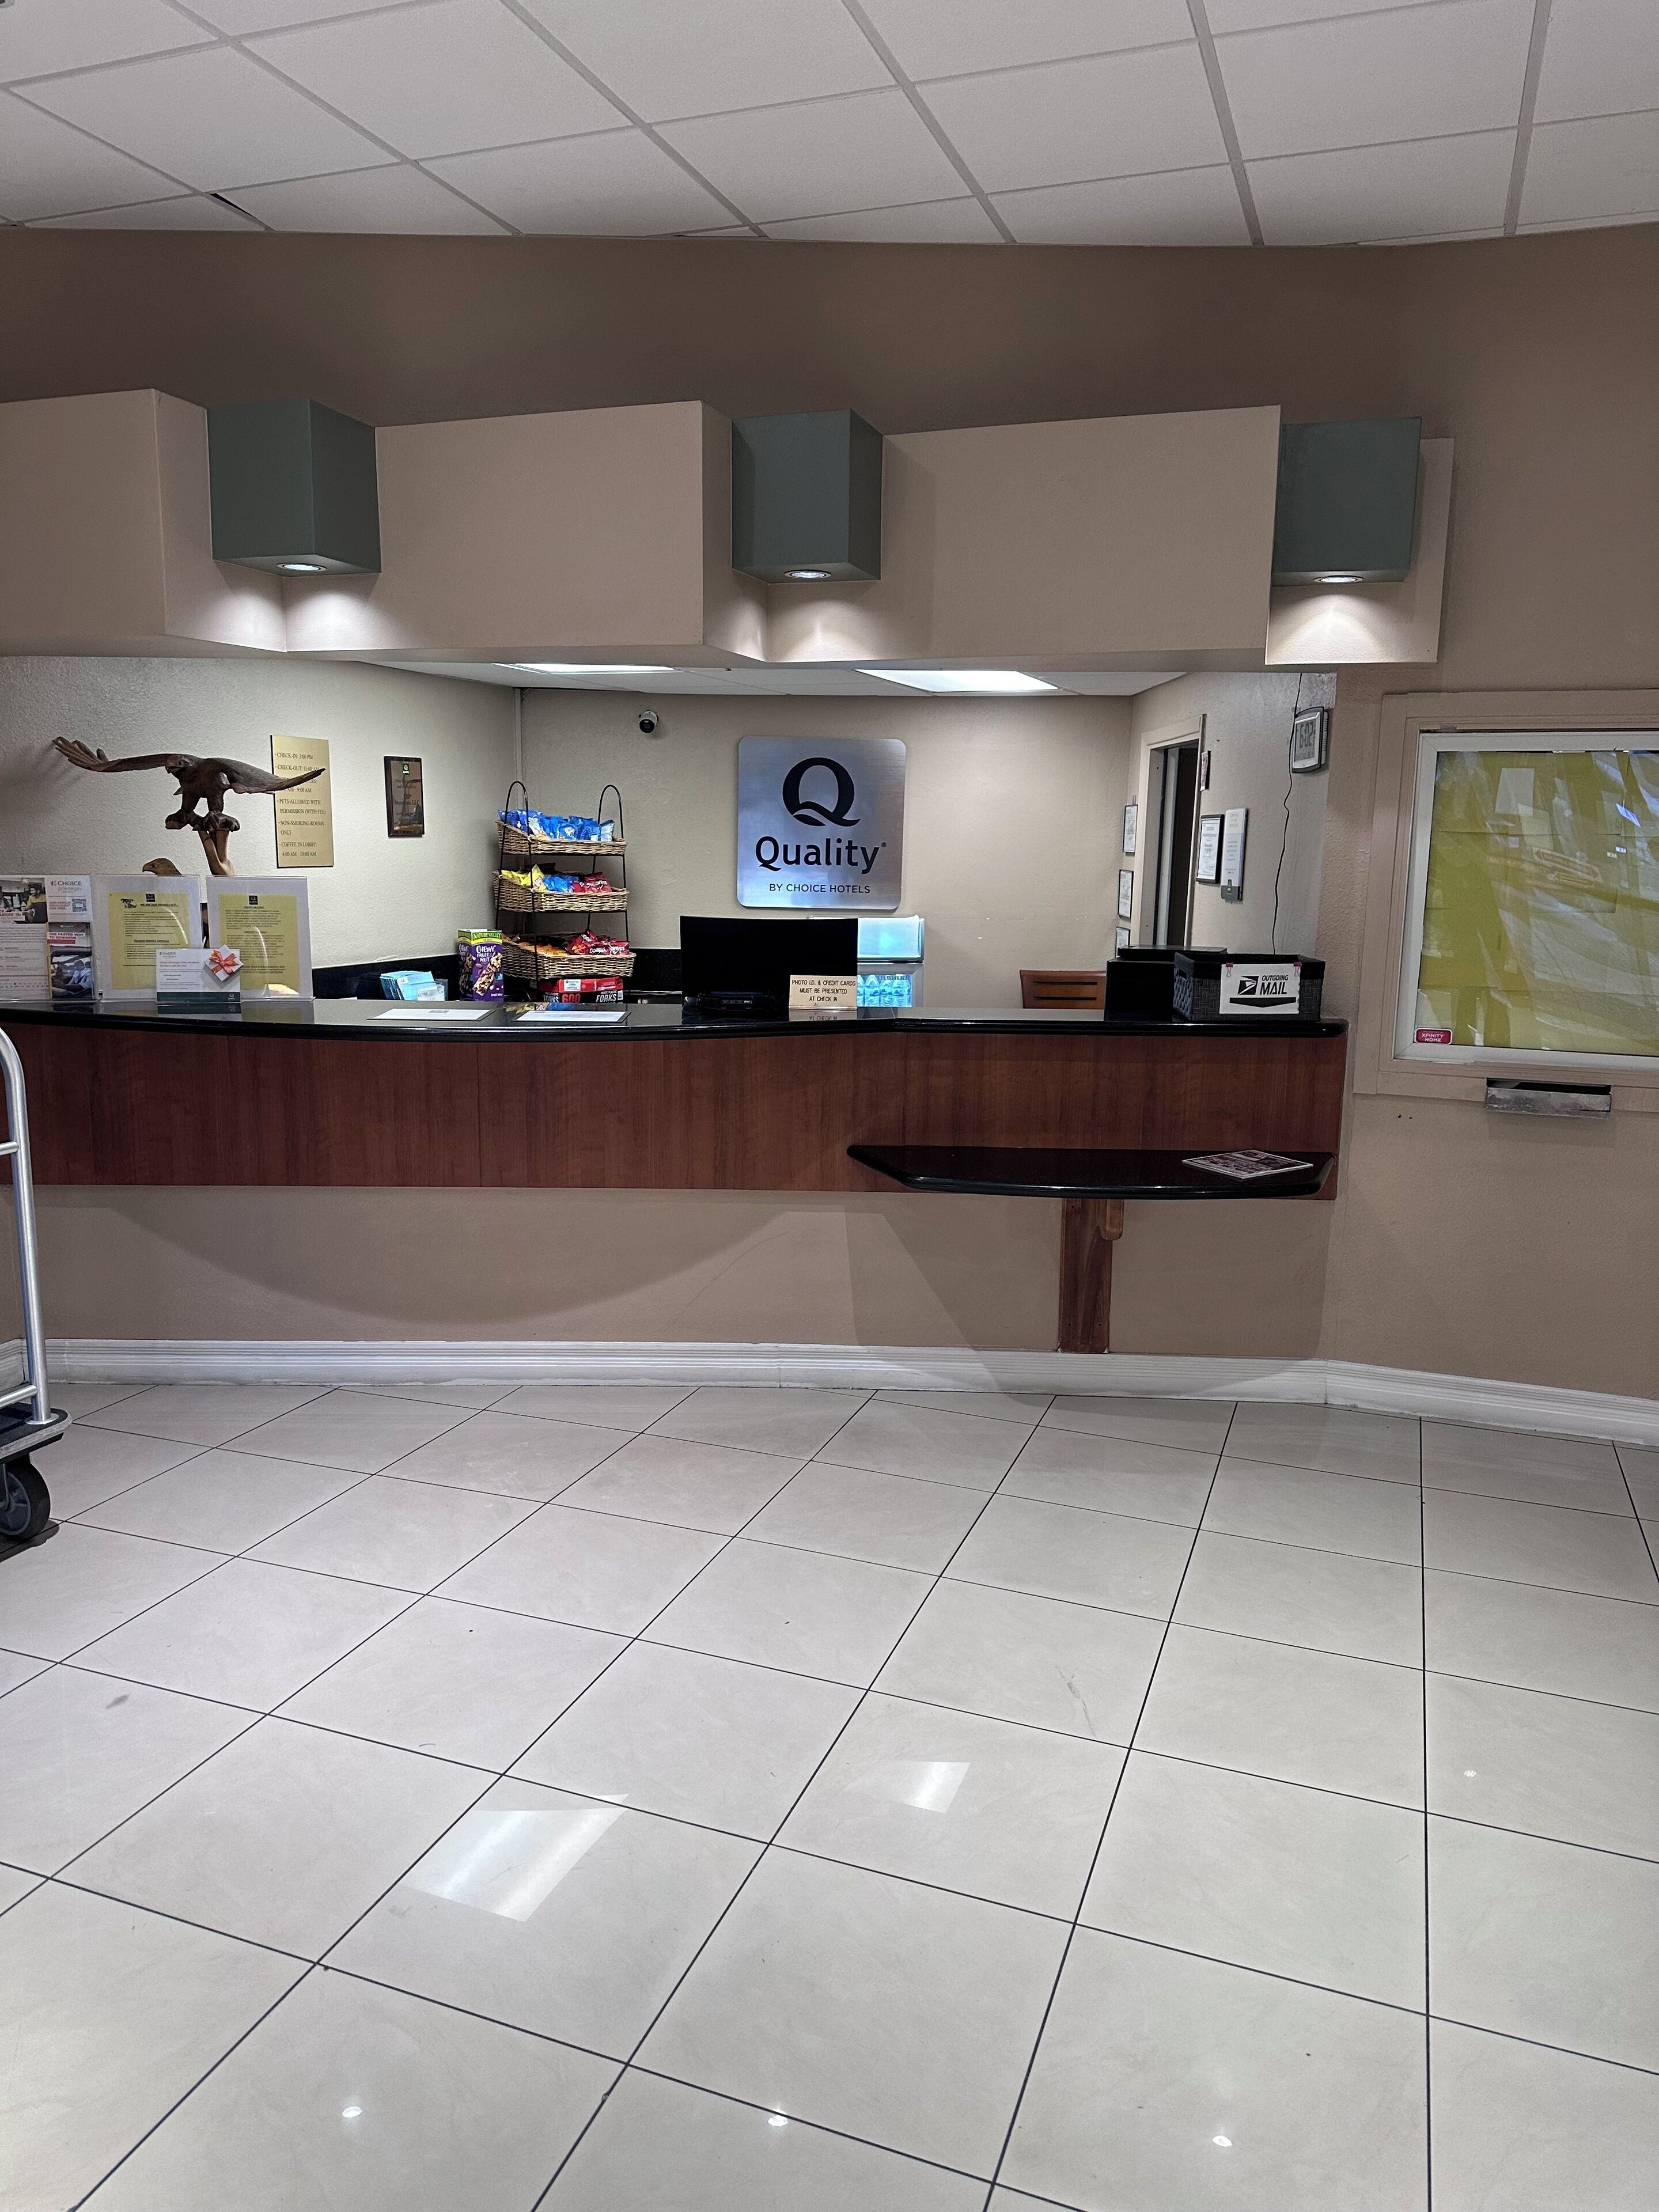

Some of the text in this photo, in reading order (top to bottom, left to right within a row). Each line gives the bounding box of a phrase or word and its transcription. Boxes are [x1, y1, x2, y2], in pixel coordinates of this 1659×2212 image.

[782, 757, 861, 827] Q
[770, 883, 871, 893] BY CHOICE HOTELS
[476, 945, 496, 953] CHEWY
[1260, 982, 1287, 995] MAIL
[562, 993, 581, 1003] 600
[596, 994, 617, 1003] FORKS
